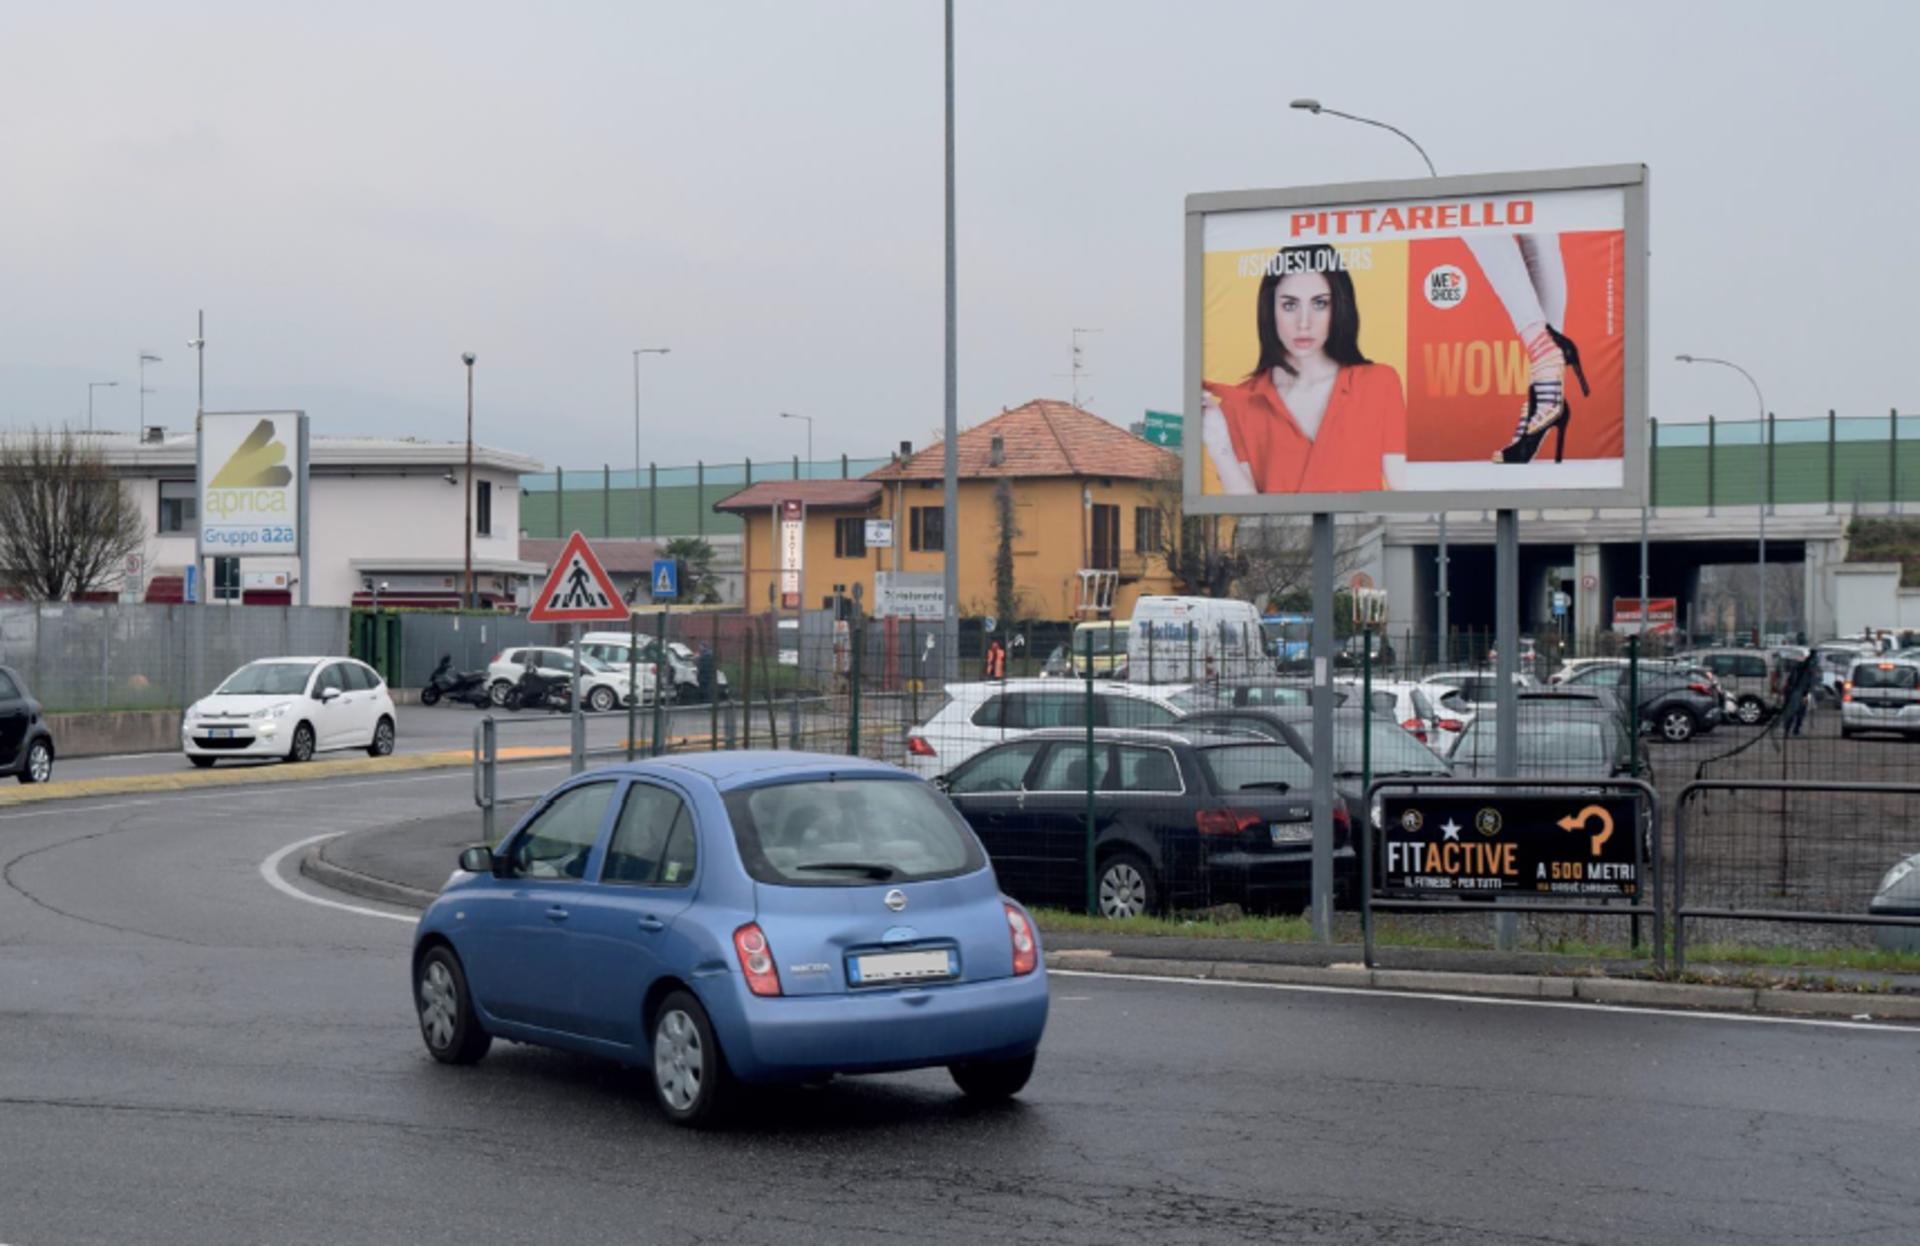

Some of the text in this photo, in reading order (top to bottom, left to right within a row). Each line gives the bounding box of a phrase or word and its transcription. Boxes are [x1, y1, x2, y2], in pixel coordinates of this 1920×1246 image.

[1290, 200, 1534, 238] PITTARELLO
[1236, 247, 1374, 278] #SHOESLOVERS
[1431, 272, 1450, 288] WE
[1431, 288, 1461, 301] SHOES
[1423, 340, 1531, 397] WOW
[206, 490, 288, 520] aprica
[206, 527, 295, 546] Gruppo a2a
[1387, 841, 1519, 876] FITACTIVE
[1536, 861, 1636, 880] A 500 METRI
[1477, 878, 1503, 889] TUTTI
